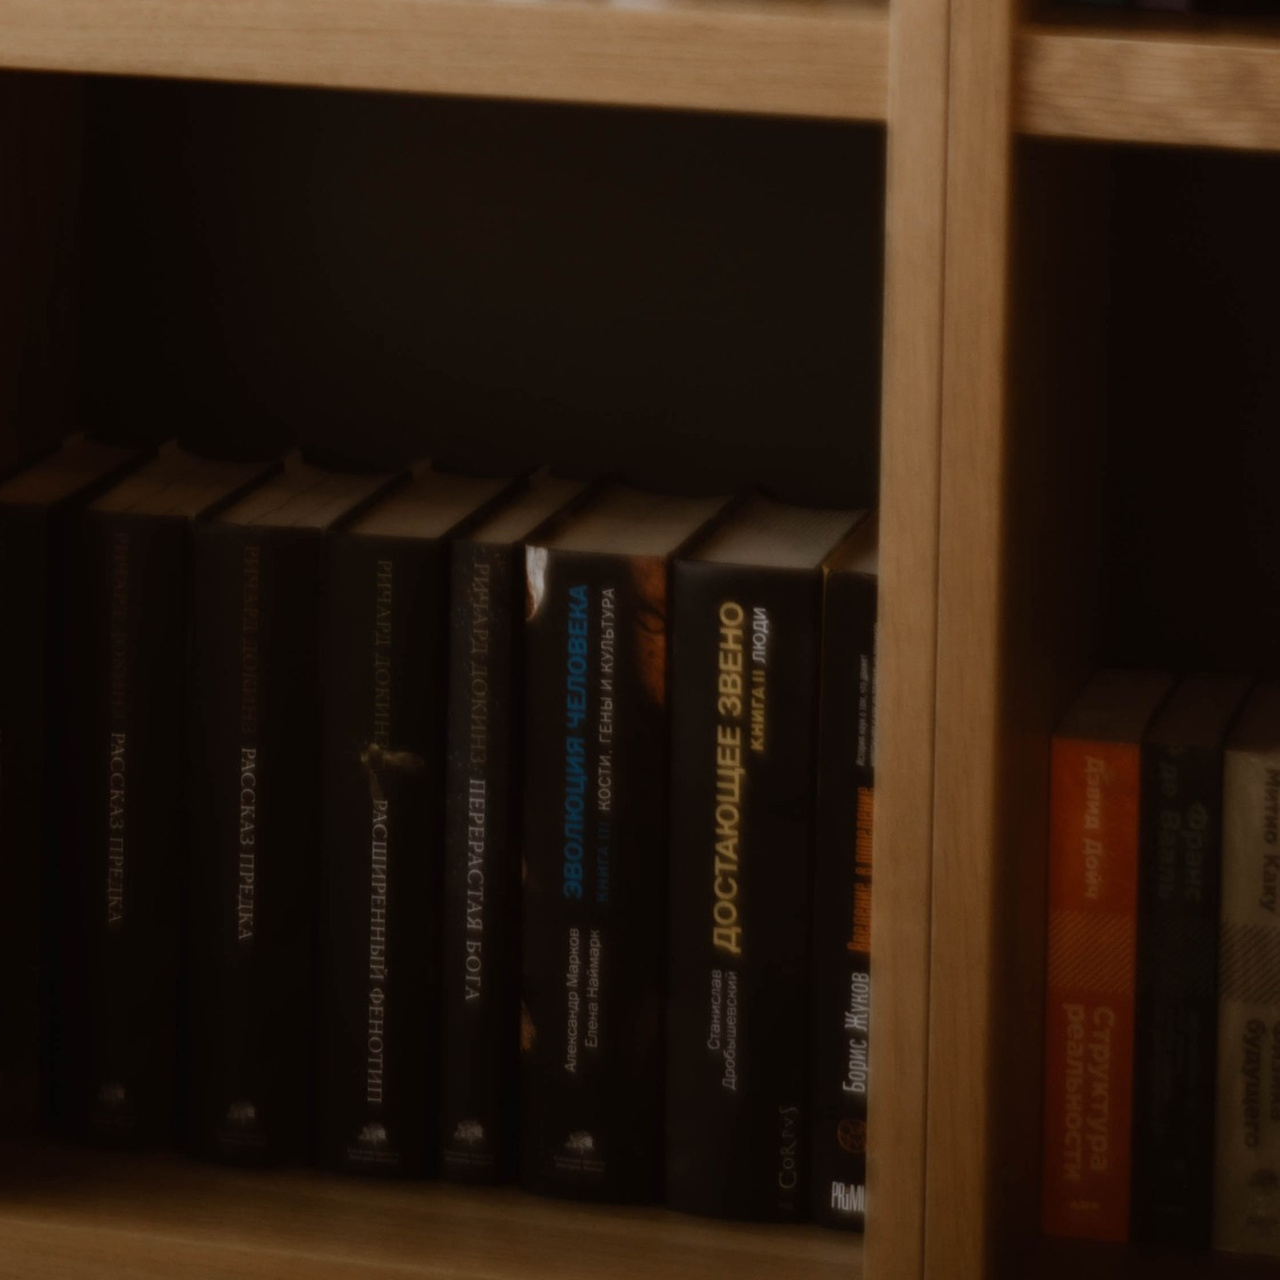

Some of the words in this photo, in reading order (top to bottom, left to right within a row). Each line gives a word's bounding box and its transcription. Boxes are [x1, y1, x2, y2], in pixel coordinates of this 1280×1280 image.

[374, 560, 394, 646] РИЧАРД
[471, 562, 490, 654] РИЧАРД
[599, 588, 616, 673] КУЛЬТУРА
[752, 607, 768, 664] ЛЮДИ
[566, 585, 589, 730] ЧЕЛОВЕКА
[599, 678, 614, 691] И
[717, 602, 745, 716] ЗВЕНО
[598, 698, 614, 744] ГЕНЫ
[750, 688, 766, 752] КНИГА
[108, 732, 127, 829] РАССКАЗ
[238, 747, 256, 846] РАССКАЗ
[563, 738, 590, 900] ЭВОЛЮЦИЯ
[1084, 755, 1104, 828] Дэвид
[107, 837, 126, 923] ПРЕДКА
[466, 776, 487, 930] ПЕРЕРАСТАЯ
[594, 847, 610, 904] КНИГА
[713, 726, 746, 955] ДОСТАЮЩЕЕ
[1083, 838, 1104, 900] Дойч
[236, 854, 256, 941] ПРЕДКА
[368, 799, 389, 980] РАСШИРЕННЫЙ
[464, 938, 482, 1001] БОГА
[564, 928, 580, 987] Марков
[584, 930, 602, 998] Наймарк
[366, 987, 386, 1103] ФЕНОТИП
[563, 992, 580, 1072] Александр
[584, 1003, 600, 1048] Елена
[708, 970, 724, 1050] Станислав
[722, 970, 740, 1090] Дробышевский
[845, 973, 870, 1032] Жуков
[842, 1040, 870, 1094] Борис
[1062, 1003, 1085, 1181] реальности
[1084, 1006, 1116, 1171] Структура
